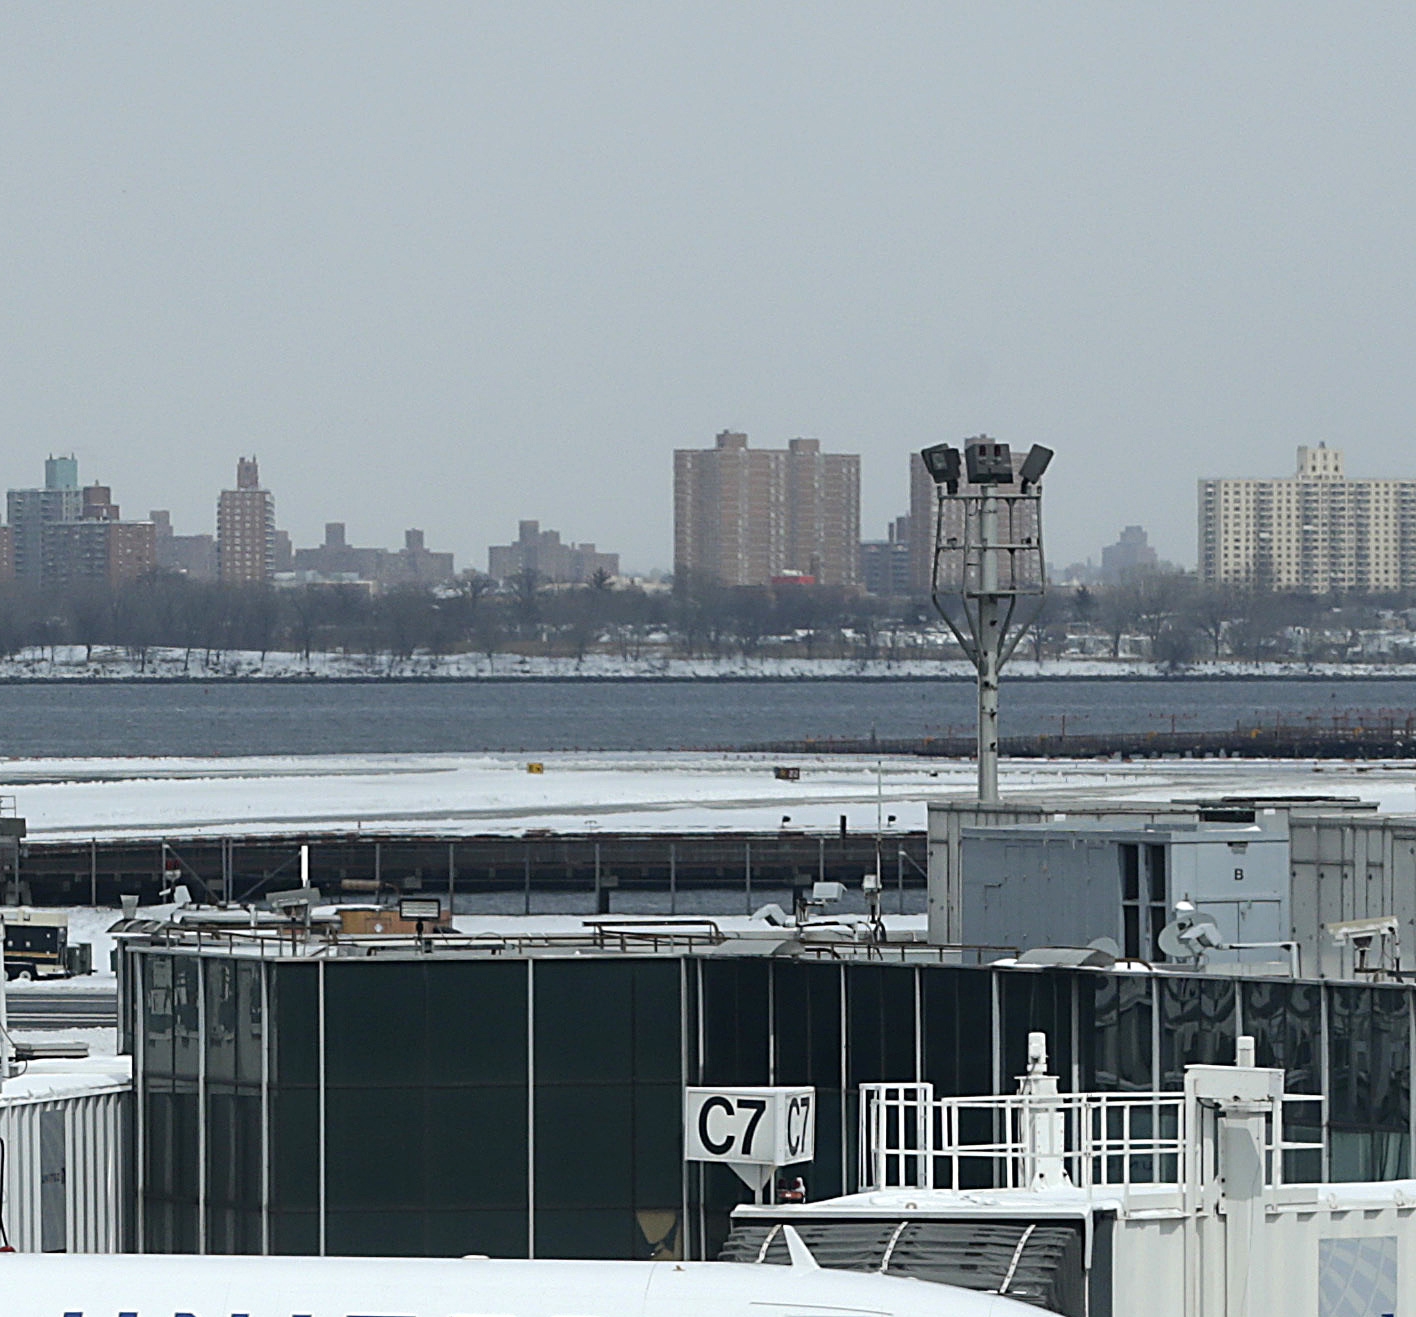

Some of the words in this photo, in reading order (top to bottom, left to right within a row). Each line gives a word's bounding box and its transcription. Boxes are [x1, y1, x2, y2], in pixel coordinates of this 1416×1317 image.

[1234, 868, 1244, 880] B
[698, 1096, 766, 1156] C7
[788, 1096, 810, 1156] C7
